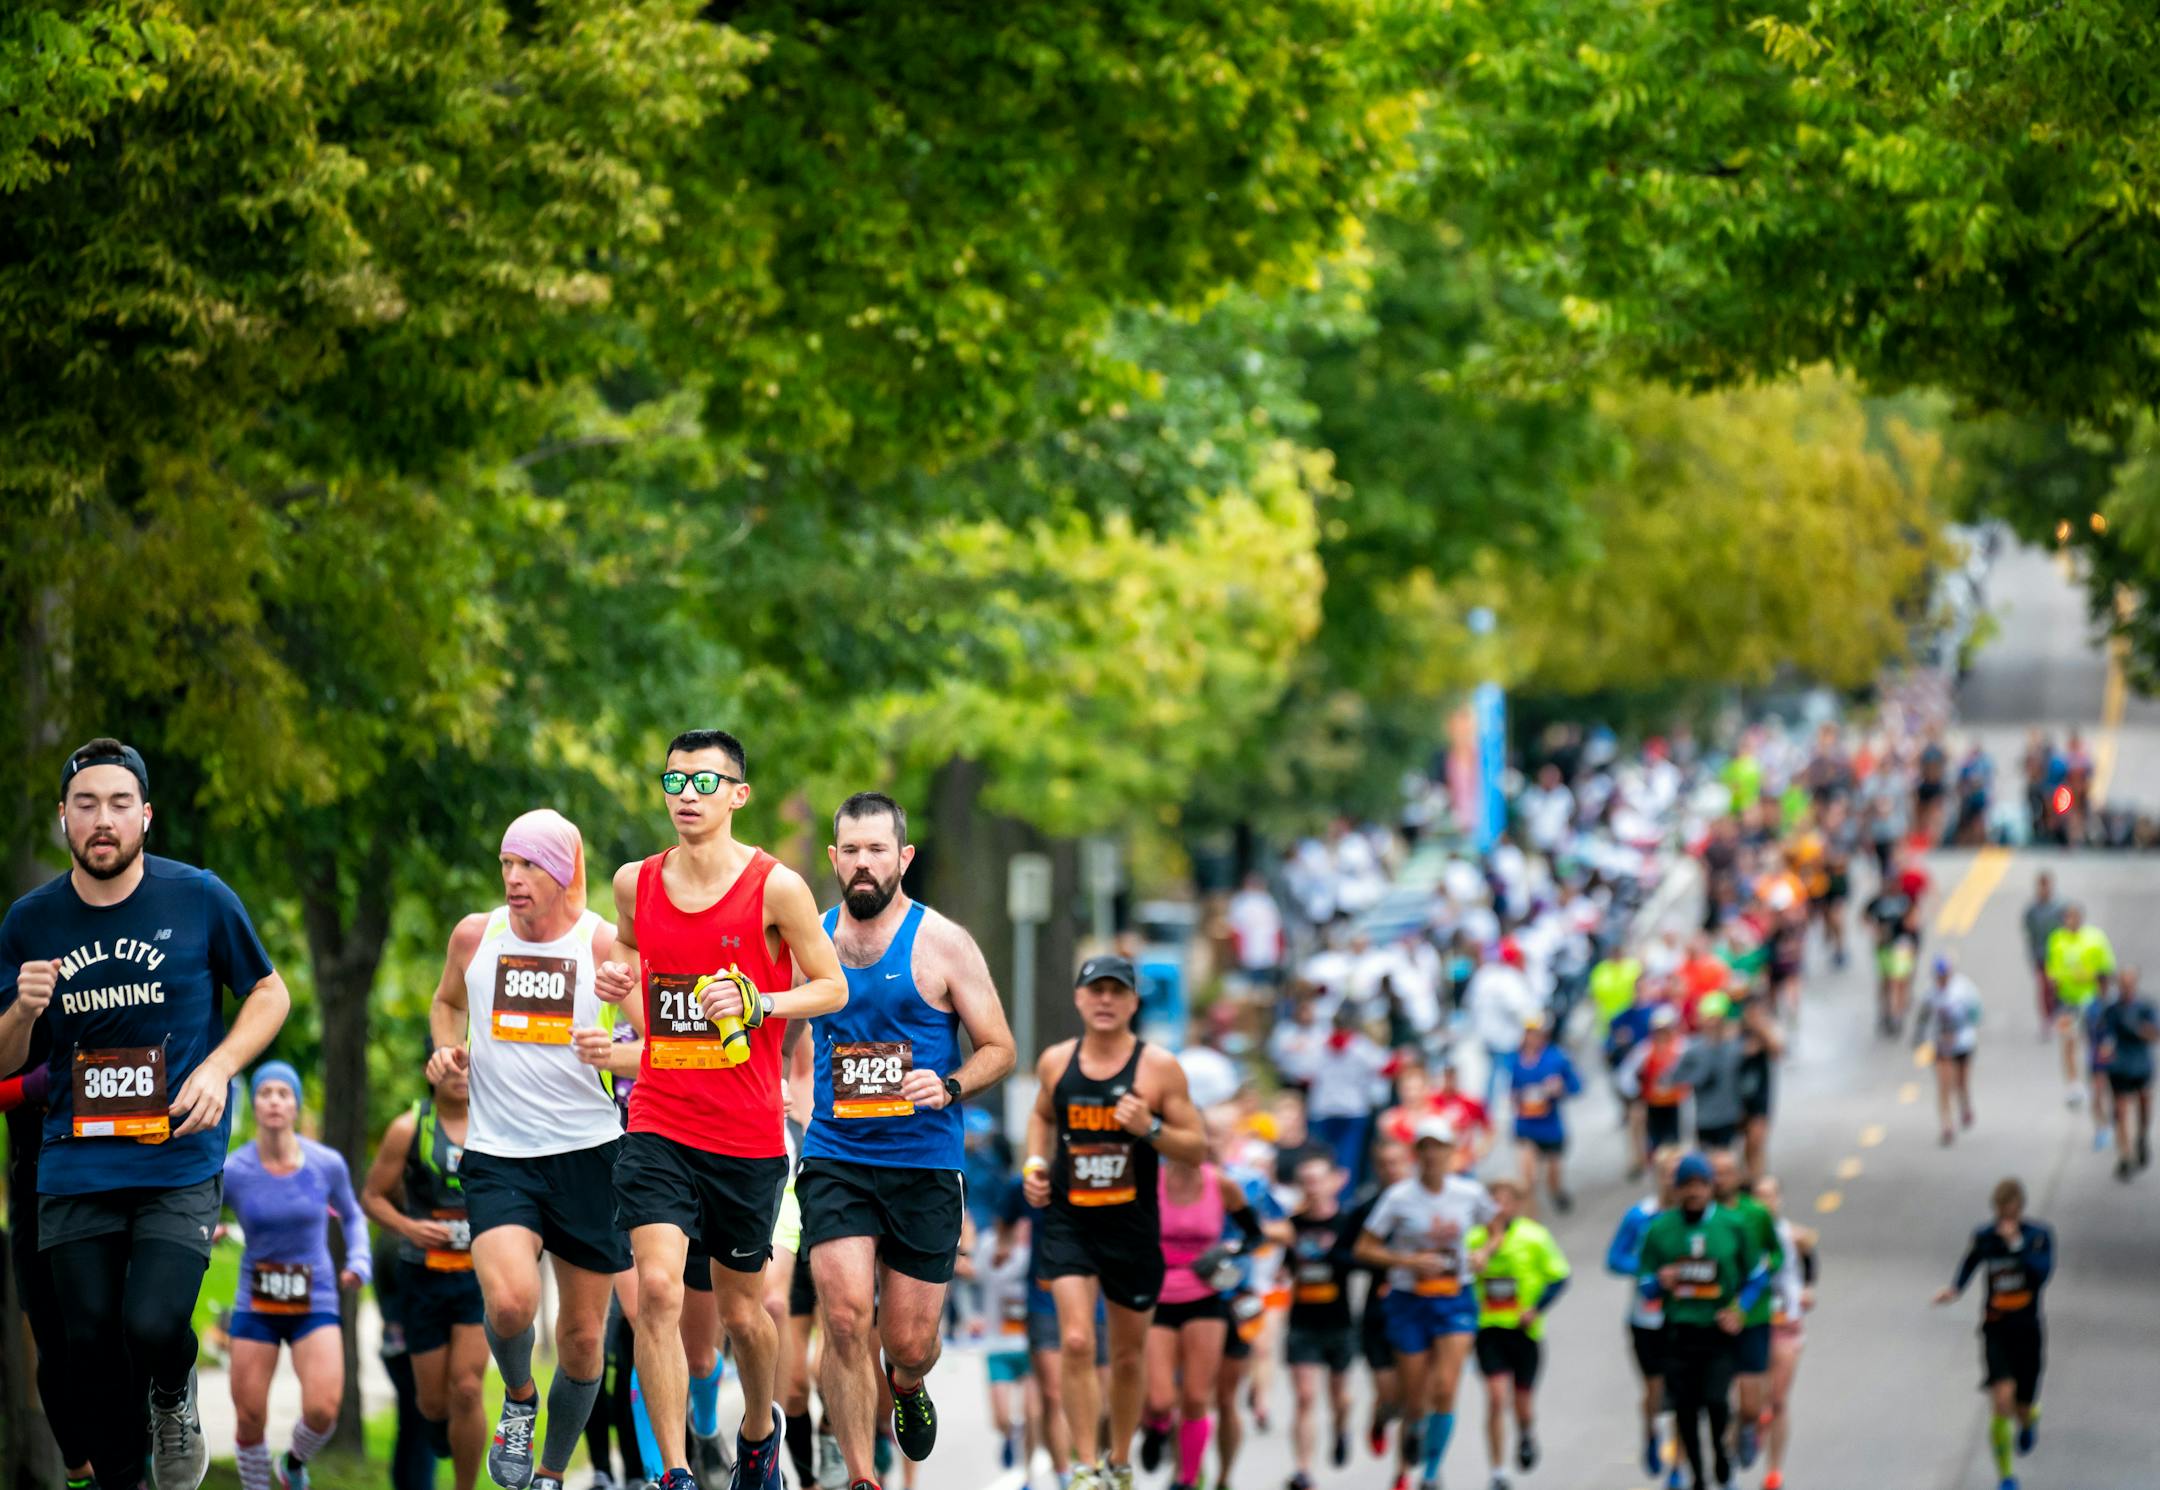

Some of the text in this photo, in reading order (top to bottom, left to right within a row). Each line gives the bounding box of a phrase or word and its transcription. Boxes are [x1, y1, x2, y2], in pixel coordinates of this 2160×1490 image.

[59, 938, 166, 981] MILL CITY
[62, 982, 165, 1015] RUNNING
[504, 969, 566, 1001] 3830
[672, 1021, 692, 1033] Fight
[149, 1051, 157, 1062] 1
[842, 1056, 903, 1085] 3428
[84, 1065, 154, 1099] 3626
[859, 1084, 882, 1095] Mark
